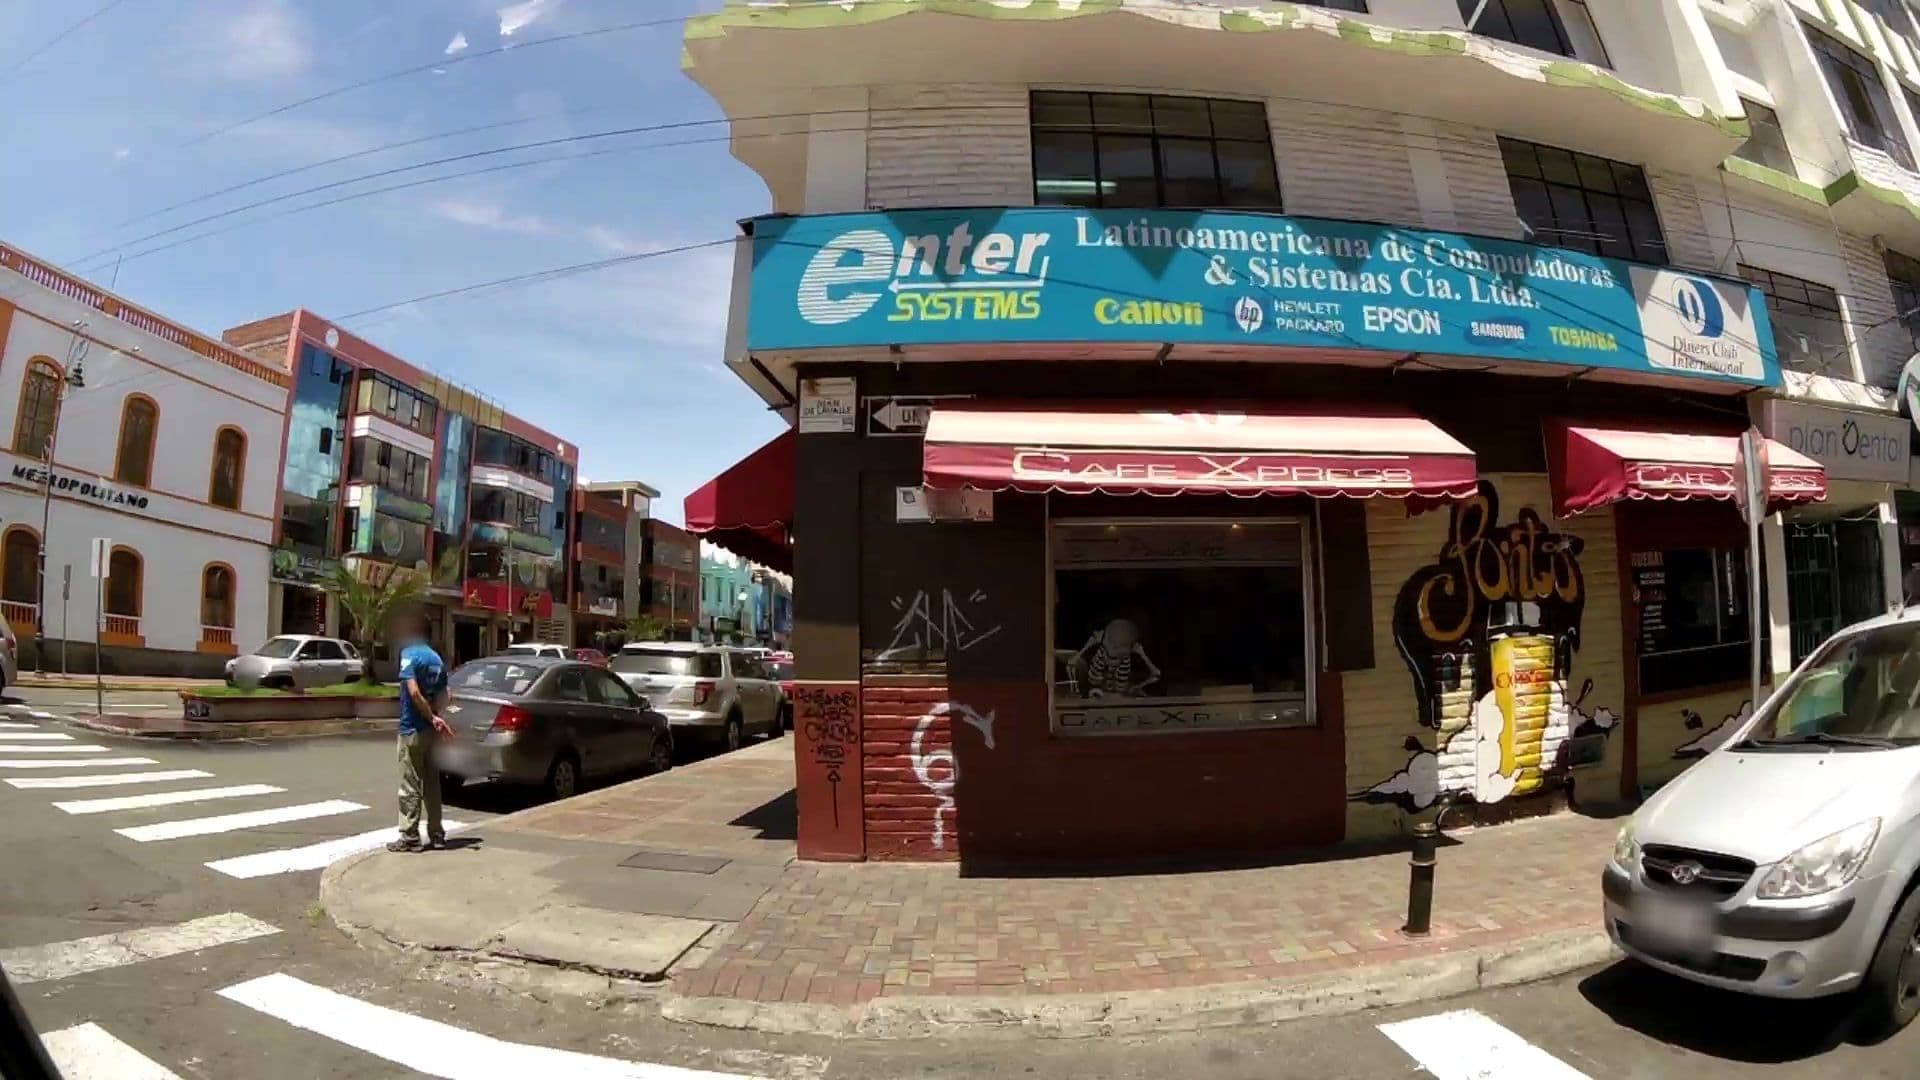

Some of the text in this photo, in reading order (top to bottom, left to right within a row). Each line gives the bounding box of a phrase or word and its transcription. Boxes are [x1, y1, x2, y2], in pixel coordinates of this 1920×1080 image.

[1073, 216, 1615, 288] Latinoamericana de Computadoras
[798, 220, 1050, 325] enter
[1204, 255, 1541, 310] & Sistemas Cía. Ltda.
[887, 291, 1041, 321] SYSTEMS
[1094, 298, 1204, 326] Canon
[1238, 298, 1262, 330] hp
[1274, 299, 1342, 315] HEWLETT
[1363, 305, 1441, 335] EPSON
[1276, 317, 1345, 334] PACKARD
[1471, 321, 1526, 340] SAMSUNG
[1548, 326, 1618, 351] TOSHIBA
[1672, 336, 1711, 357] Diners
[12, 464, 149, 509] METROPOLITANO
